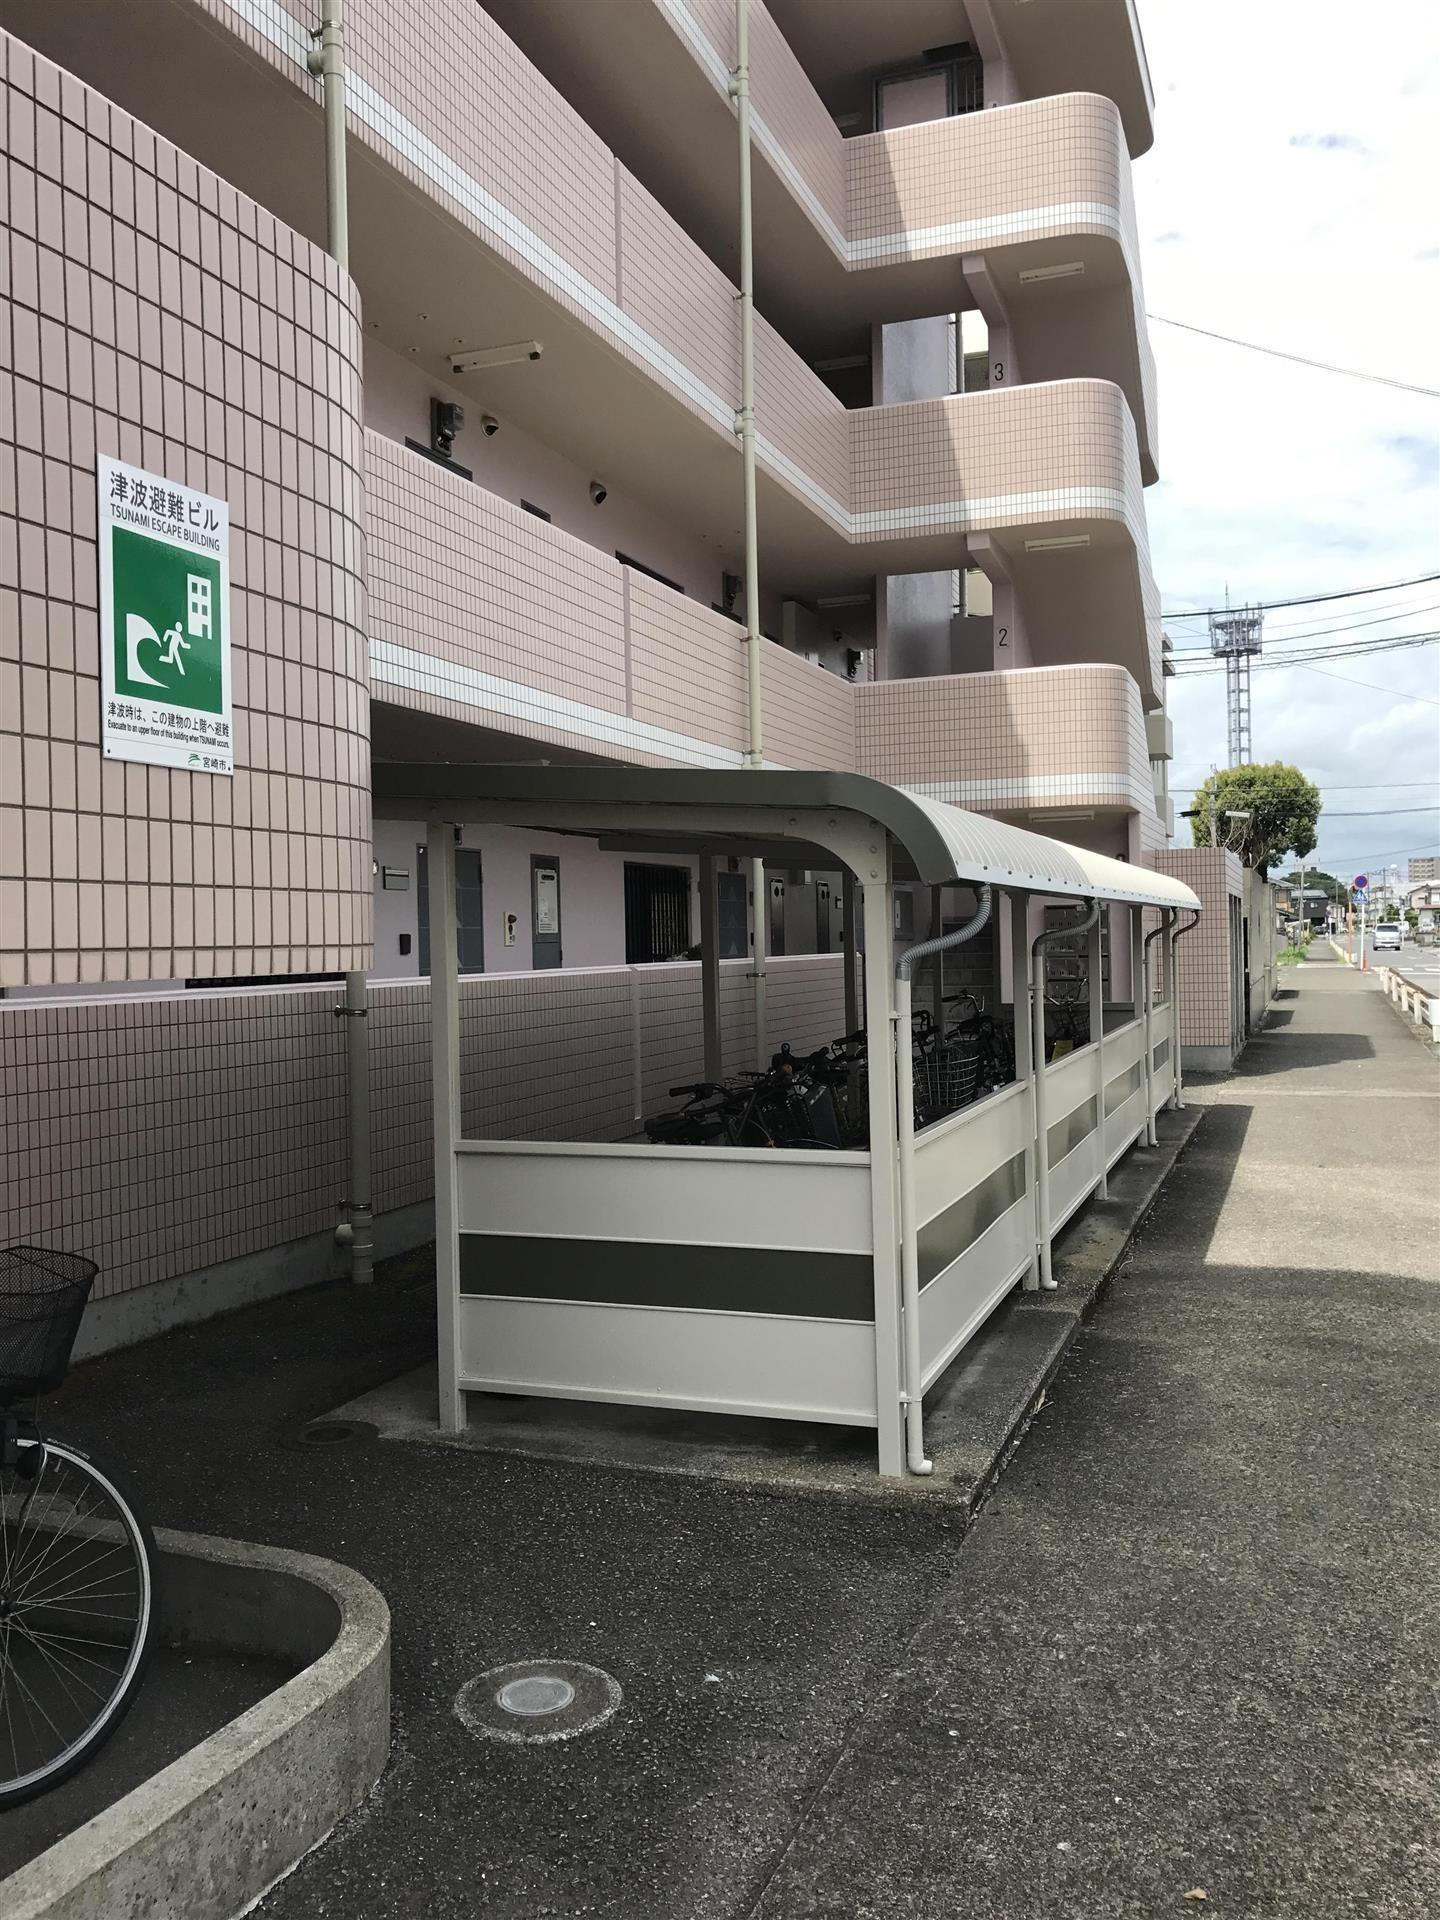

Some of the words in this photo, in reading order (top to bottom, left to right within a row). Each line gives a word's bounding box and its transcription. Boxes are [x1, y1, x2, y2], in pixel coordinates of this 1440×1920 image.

[995, 363, 1003, 381] 3
[110, 471, 219, 531] 津波避難ビル
[110, 503, 149, 528] TSUNAMI
[152, 518, 182, 539] ESCAPE
[183, 529, 220, 551] BUILDING
[999, 628, 1007, 646] 2
[108, 719, 126, 731] Evacuate
[127, 723, 132, 732] to
[132, 725, 137, 733] an
[138, 726, 150, 736] upper
[150, 726, 160, 736] floor
[160, 729, 165, 737] of
[173, 730, 189, 744] building
[189, 734, 199, 743] when
[199, 735, 216, 746] TSUNAMI
[203, 756, 227, 771] 宮崎市
